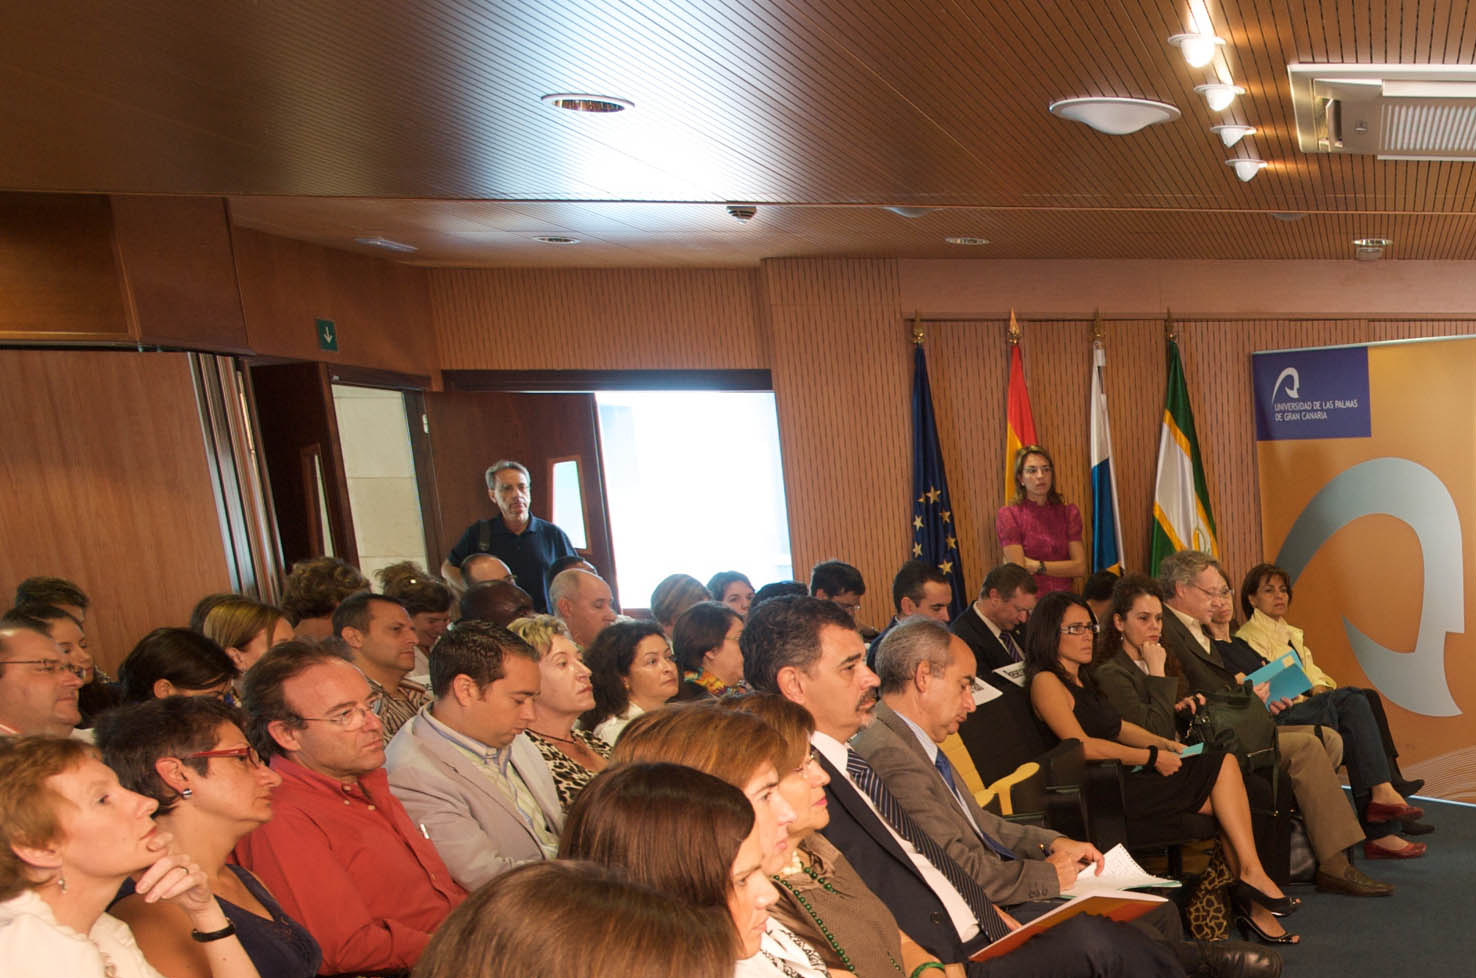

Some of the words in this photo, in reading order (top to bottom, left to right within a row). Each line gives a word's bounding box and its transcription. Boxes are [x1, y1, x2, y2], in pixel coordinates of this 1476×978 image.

[1274, 400, 1312, 411] UNIVERSIDAD
[1313, 401, 1321, 410] DE
[1322, 400, 1334, 409] LAS
[1335, 399, 1358, 409] PALMAS
[1275, 413, 1283, 421] DE
[1284, 412, 1300, 421] GRAN
[1301, 411, 1328, 420] CANARIA
